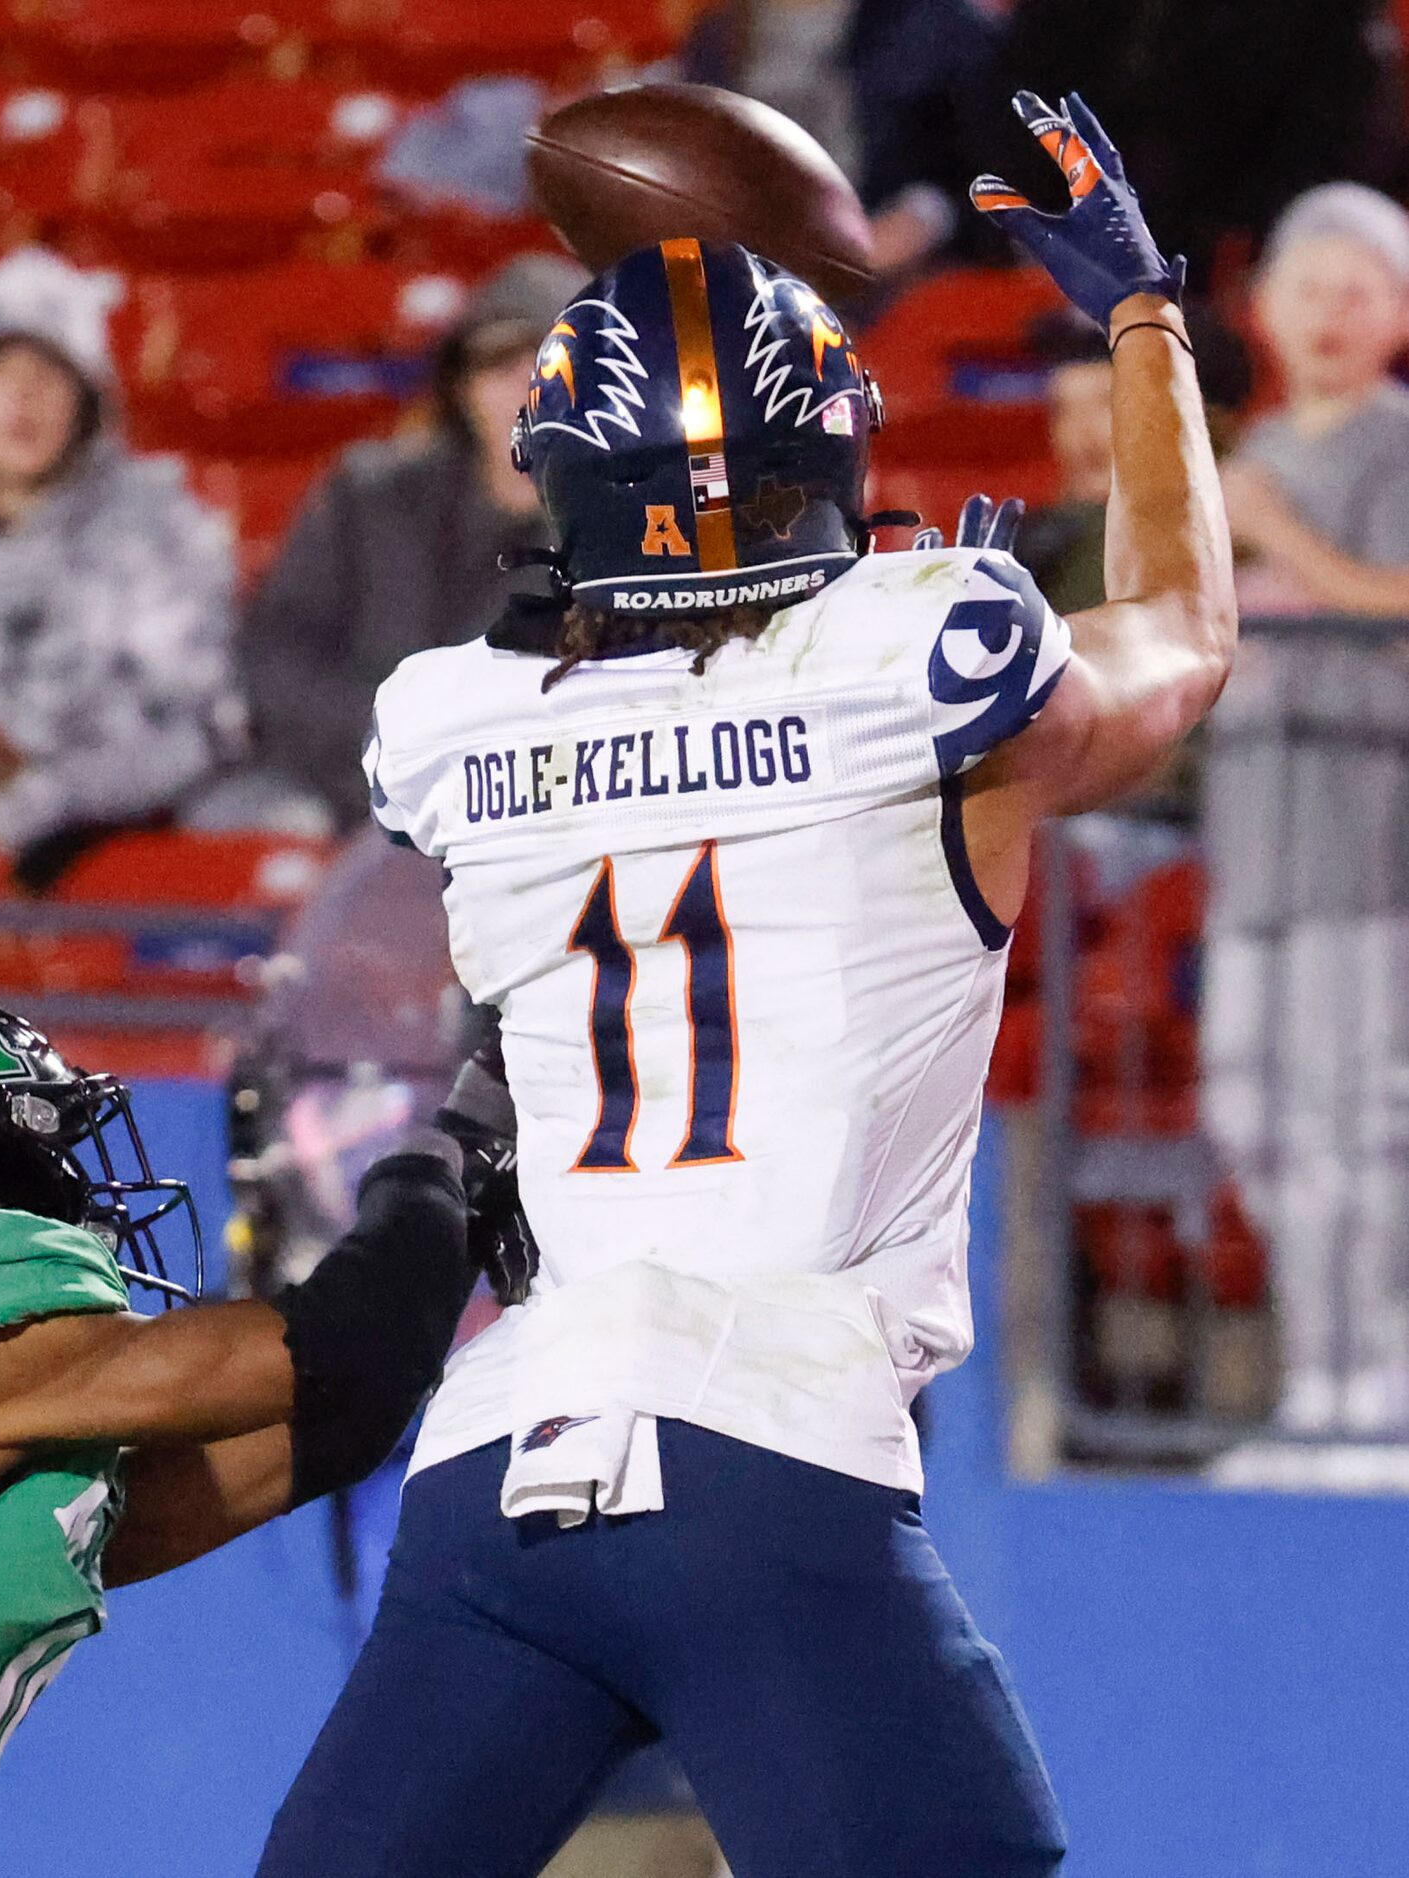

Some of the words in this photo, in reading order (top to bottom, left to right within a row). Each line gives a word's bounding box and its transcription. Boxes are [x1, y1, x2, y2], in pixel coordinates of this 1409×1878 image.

[612, 569, 826, 610] ROADRUNNERS
[464, 715, 812, 824] OGLE-KELLOGG
[565, 838, 747, 1174] 11
